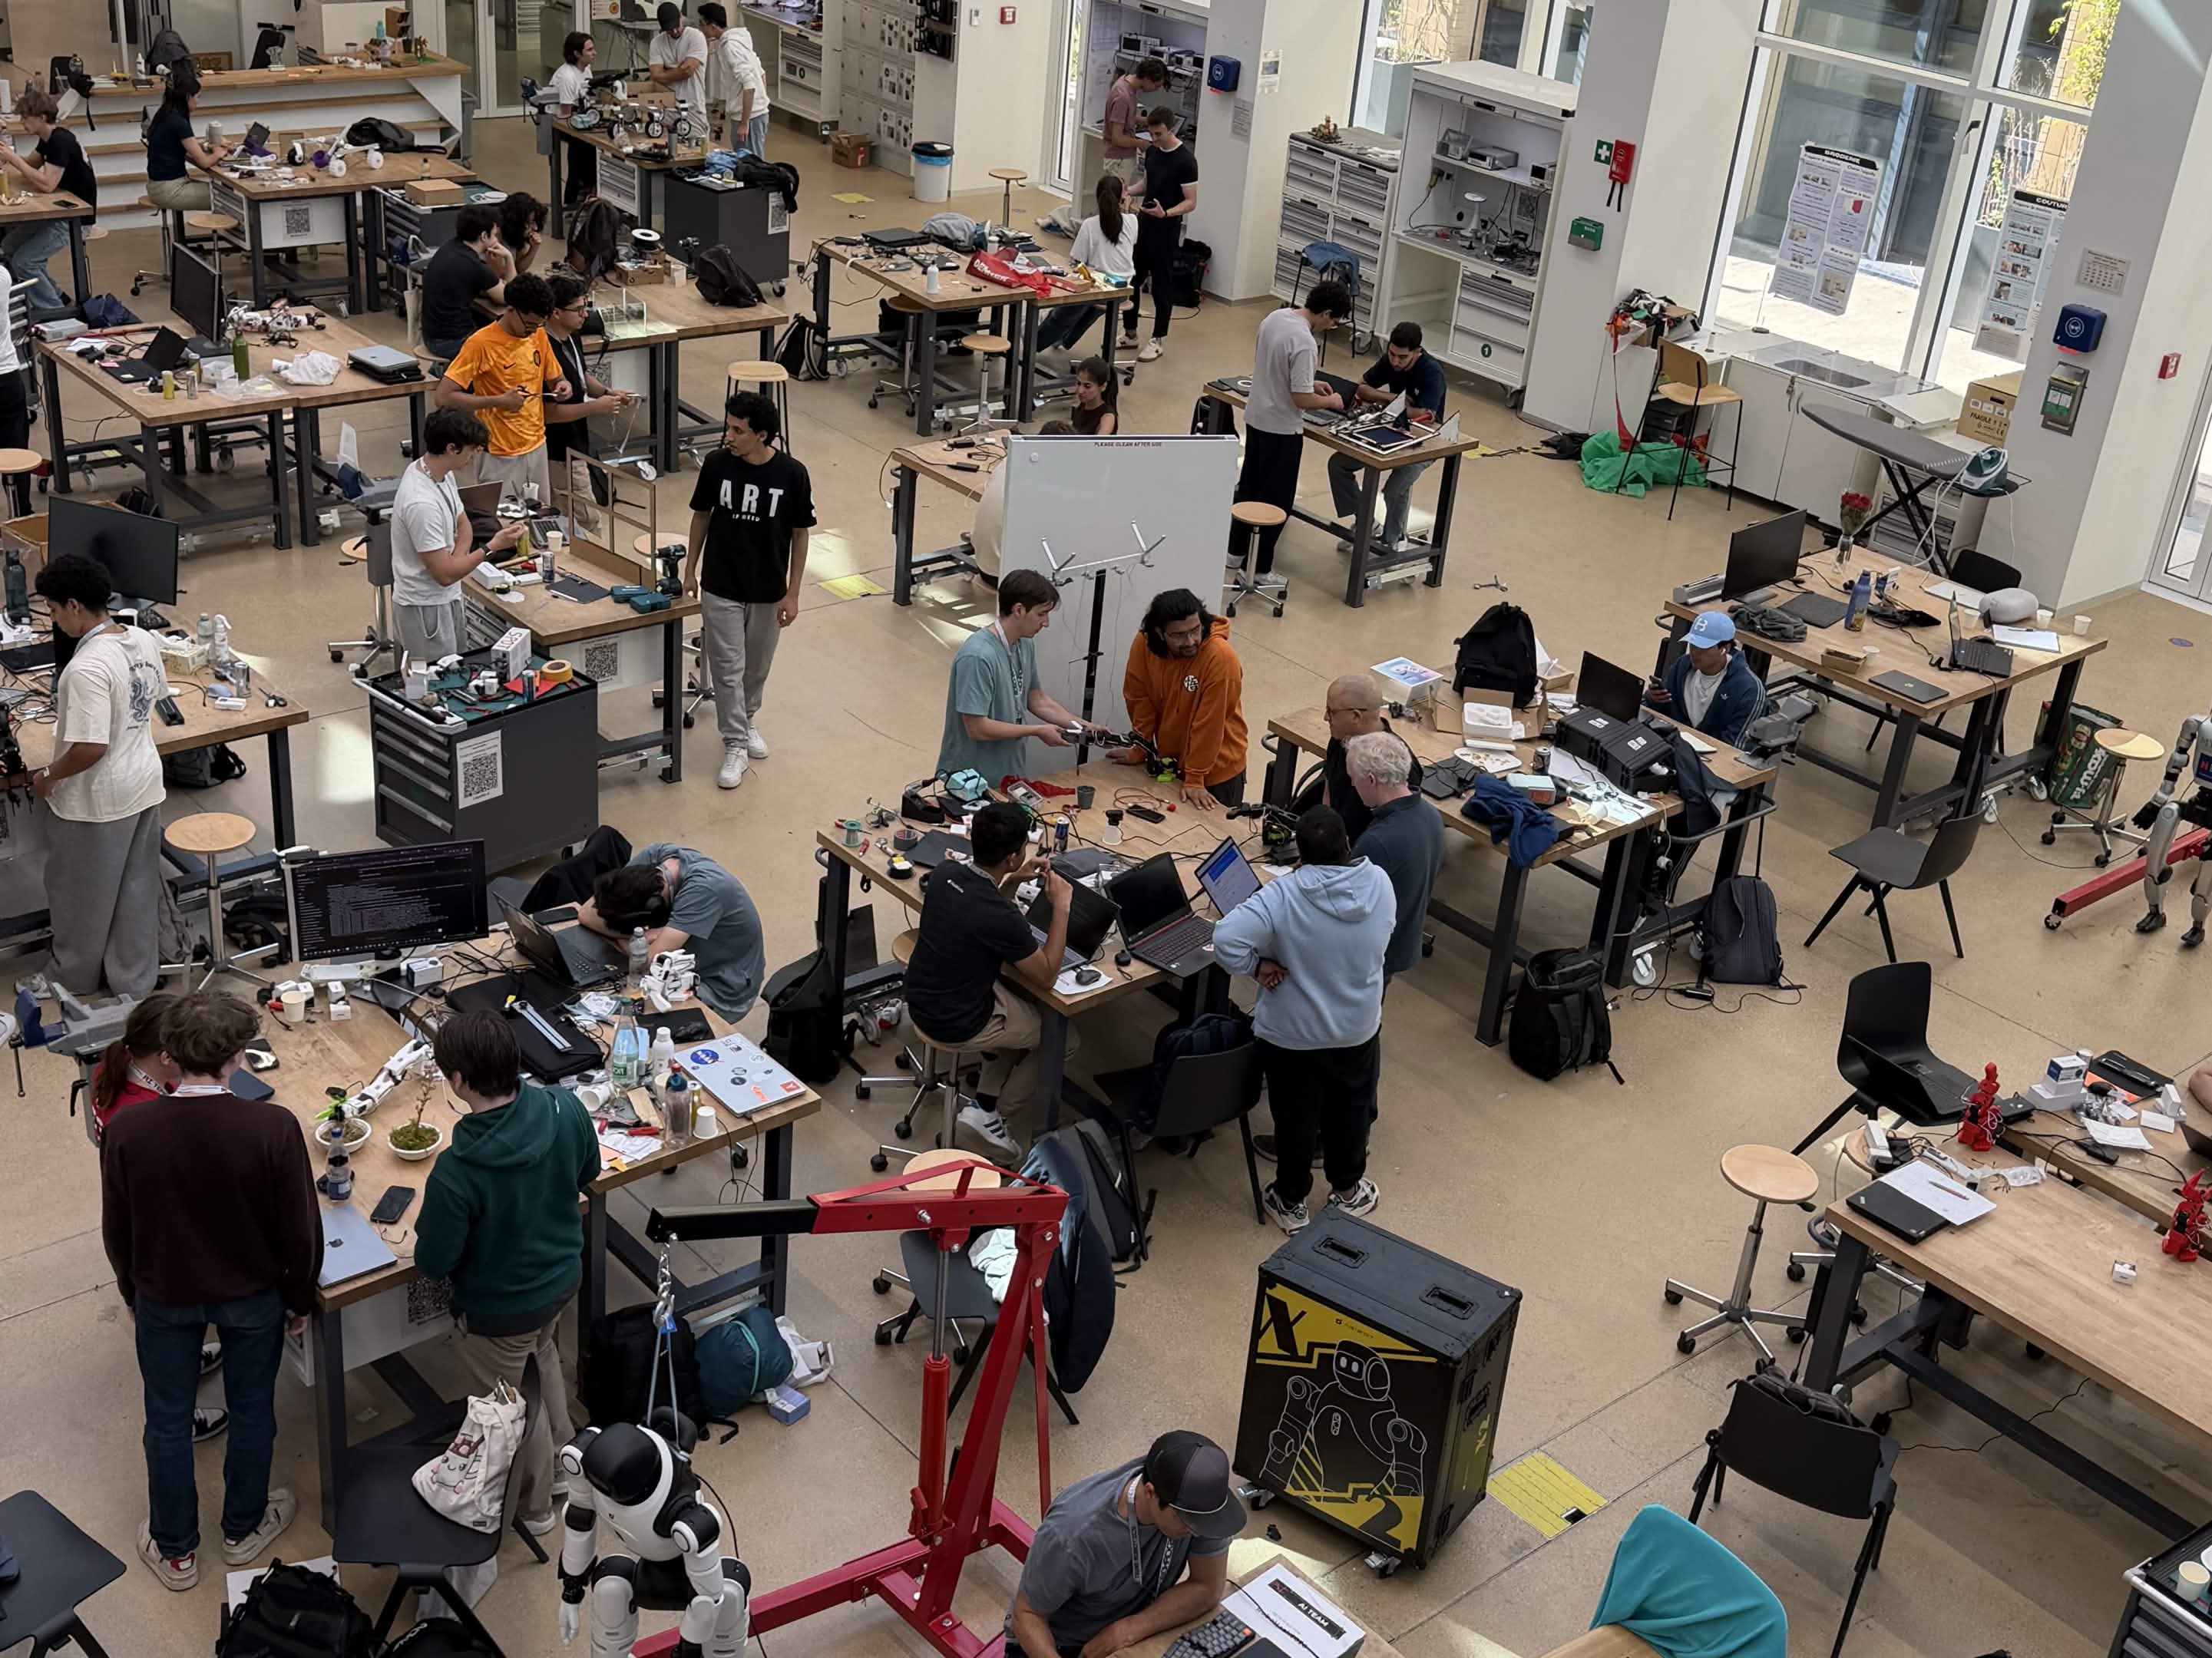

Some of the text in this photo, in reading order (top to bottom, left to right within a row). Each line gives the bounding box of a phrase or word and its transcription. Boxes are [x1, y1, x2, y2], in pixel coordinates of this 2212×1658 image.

[1970, 411, 1992, 424] FRAGILE
[1357, 1494, 1404, 1551] 2
[1308, 1607, 1329, 1627] TEAM
